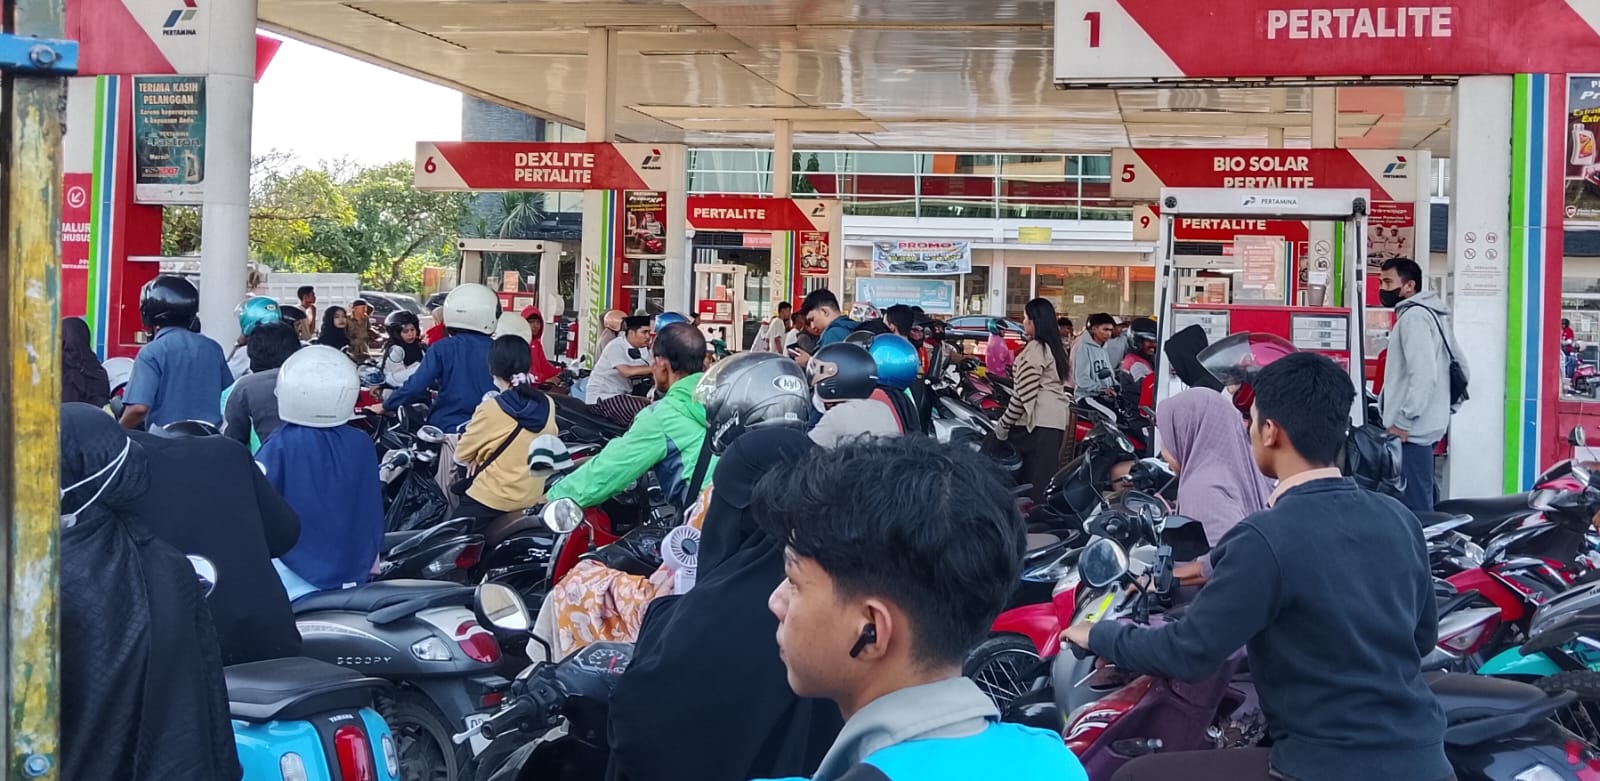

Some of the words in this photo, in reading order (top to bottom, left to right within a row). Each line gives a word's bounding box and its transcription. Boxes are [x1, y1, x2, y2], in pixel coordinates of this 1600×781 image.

[1083, 11, 1101, 48] 1
[1267, 6, 1452, 40] PERTALITE
[139, 82, 170, 93] TERIMA
[173, 82, 199, 92] KASIH
[143, 95, 194, 105] PELANGGAN
[424, 156, 437, 173] 6
[514, 152, 595, 168] DEXLITE
[1213, 156, 1246, 172] BIO
[1249, 156, 1309, 171] SOLAR
[514, 168, 592, 184] PERTALITE
[1121, 164, 1136, 183] 5
[1261, 198, 1297, 206] PERTAMINA
[693, 207, 766, 220] PERTALITE
[1140, 215, 1150, 229] 9
[1182, 218, 1267, 231] PERTALITE
[337, 656, 392, 665] SCOOPY
